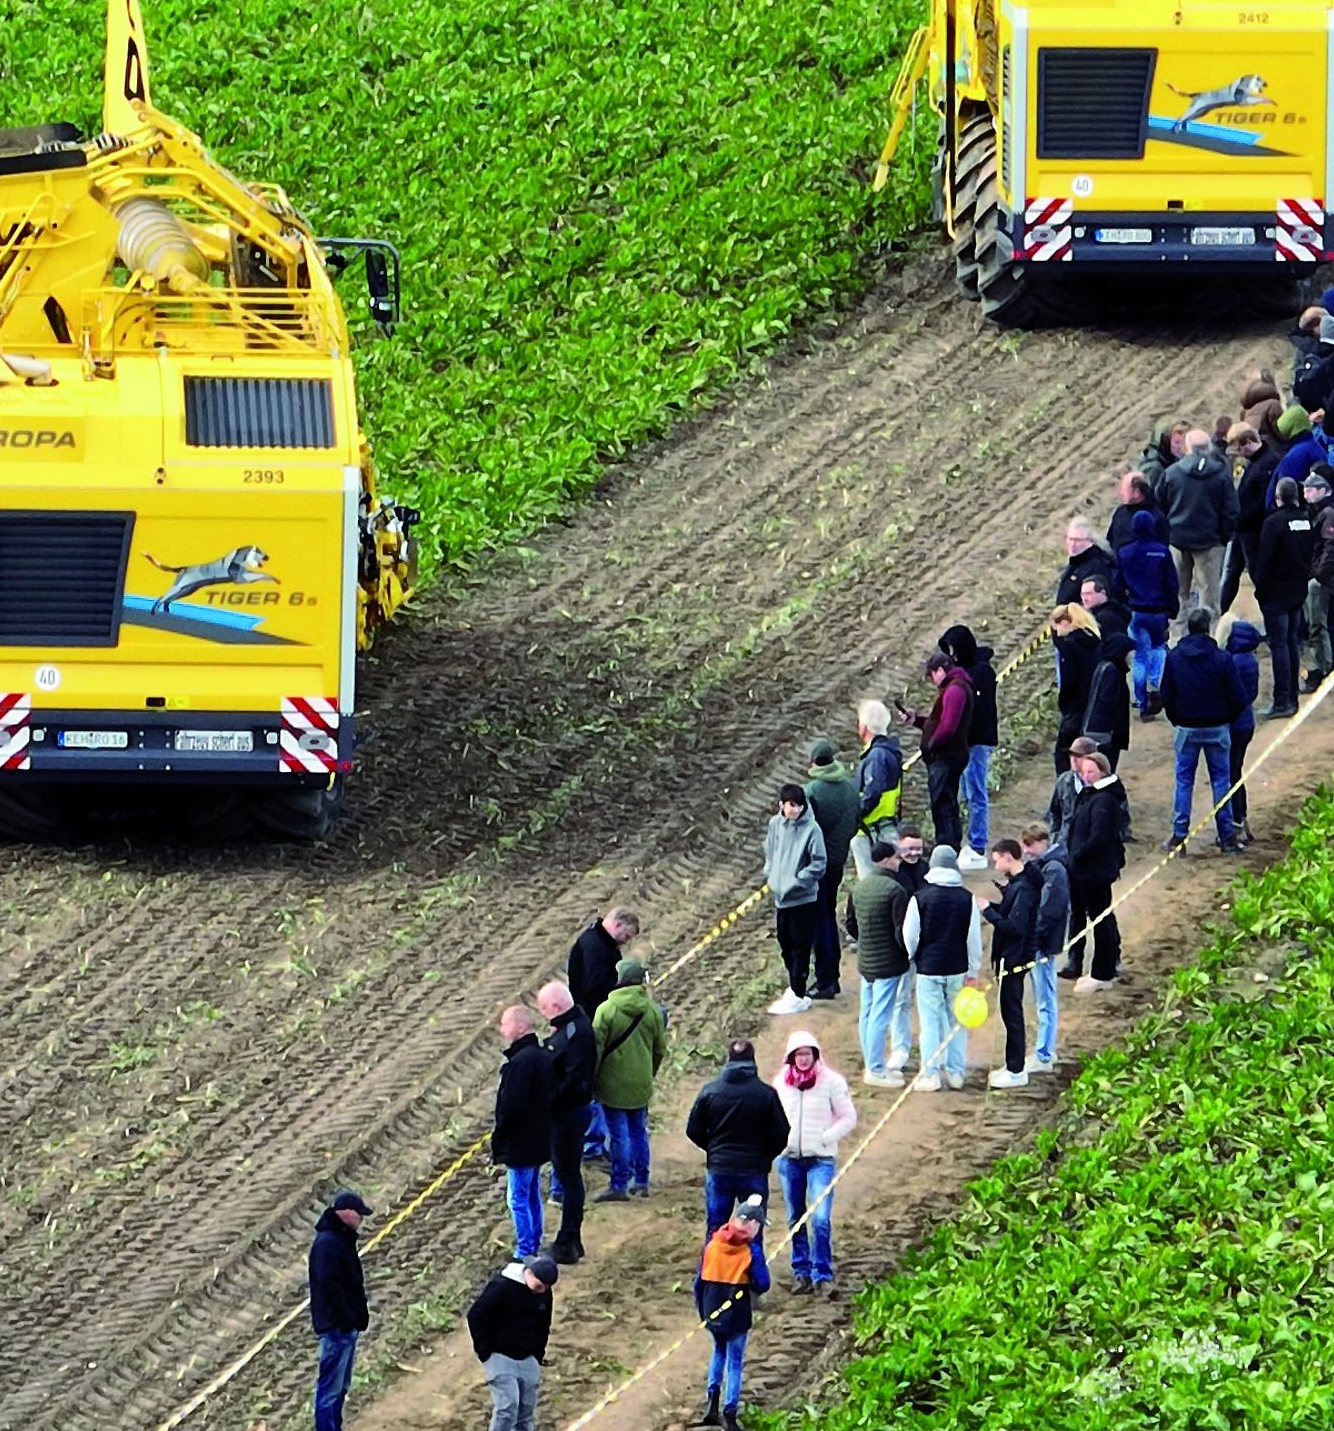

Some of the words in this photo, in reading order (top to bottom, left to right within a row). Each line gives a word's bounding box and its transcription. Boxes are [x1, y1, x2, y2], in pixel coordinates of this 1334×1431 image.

[1238, 13, 1270, 25] 2412
[1215, 112, 1277, 125] TIGER
[1075, 178, 1089, 192] 40
[243, 470, 285, 484] 2393
[205, 591, 281, 606] TIGER
[39, 669, 57, 686] 40
